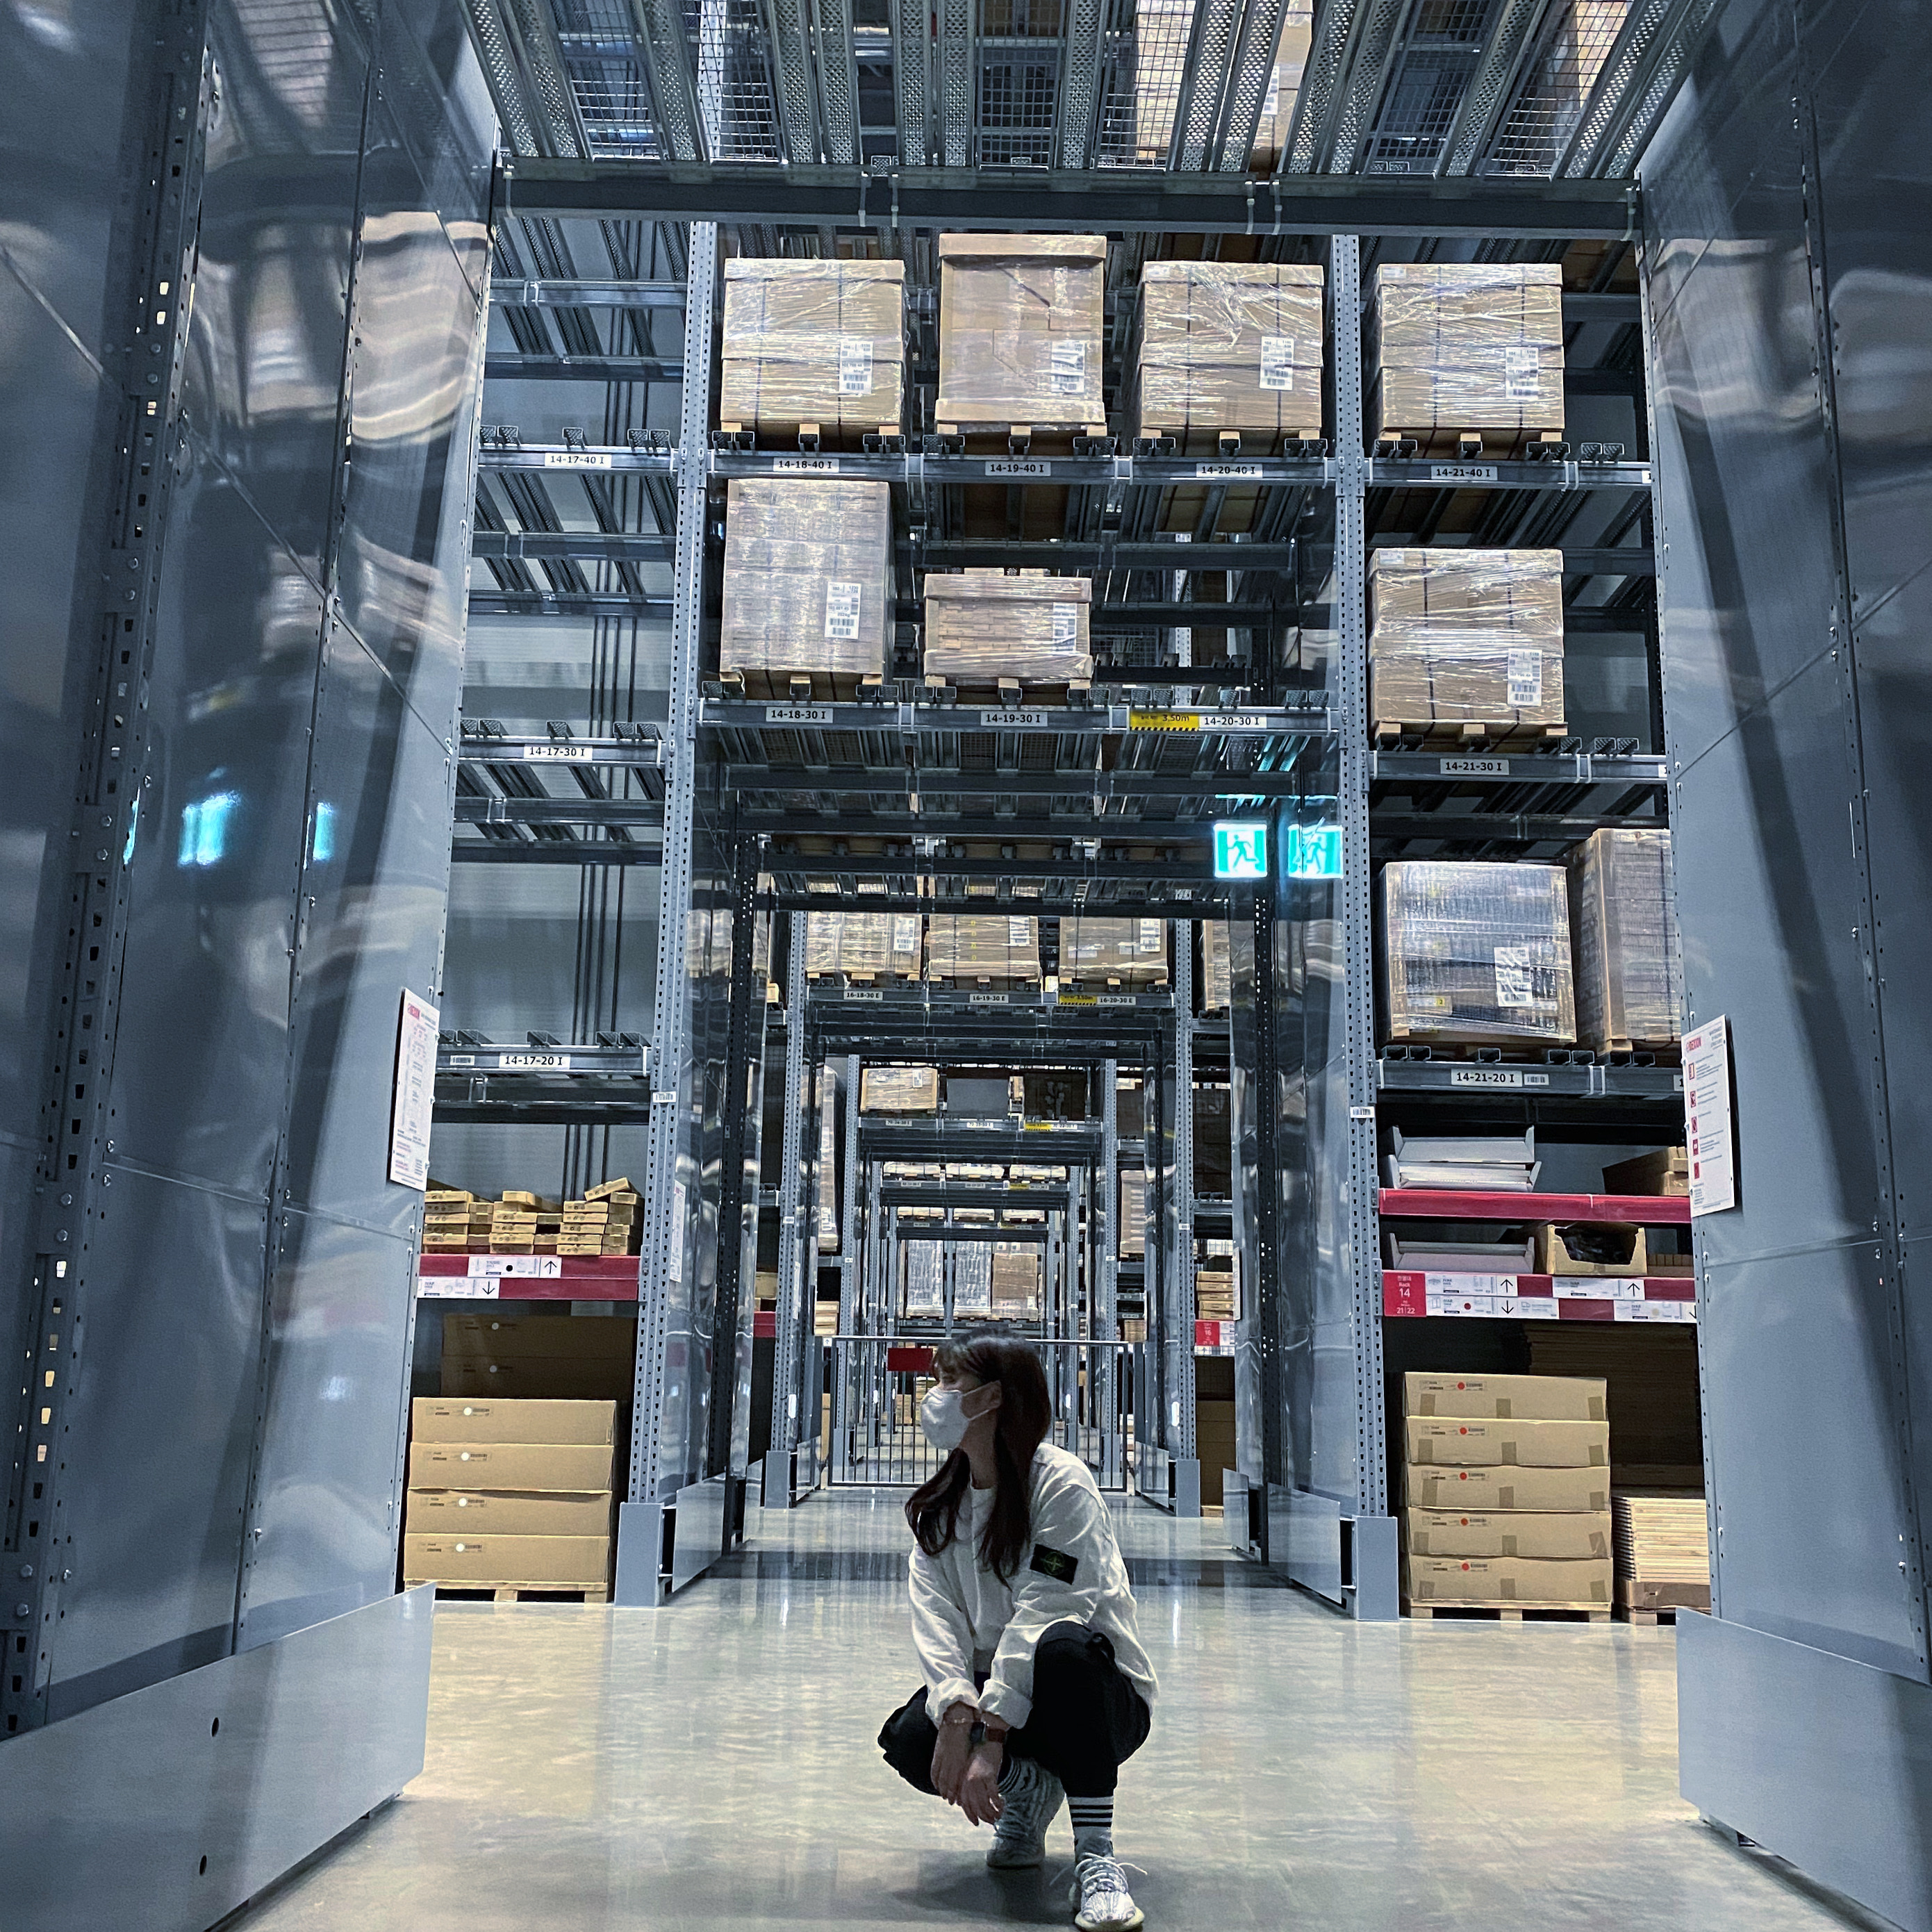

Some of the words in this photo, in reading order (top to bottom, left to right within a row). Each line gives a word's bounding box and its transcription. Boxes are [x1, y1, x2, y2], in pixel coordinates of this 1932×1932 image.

[505, 1057, 554, 1065] 14-17-20
[1457, 1073, 1505, 1082] 14-21-20
[1399, 1288, 1410, 1298] 14
